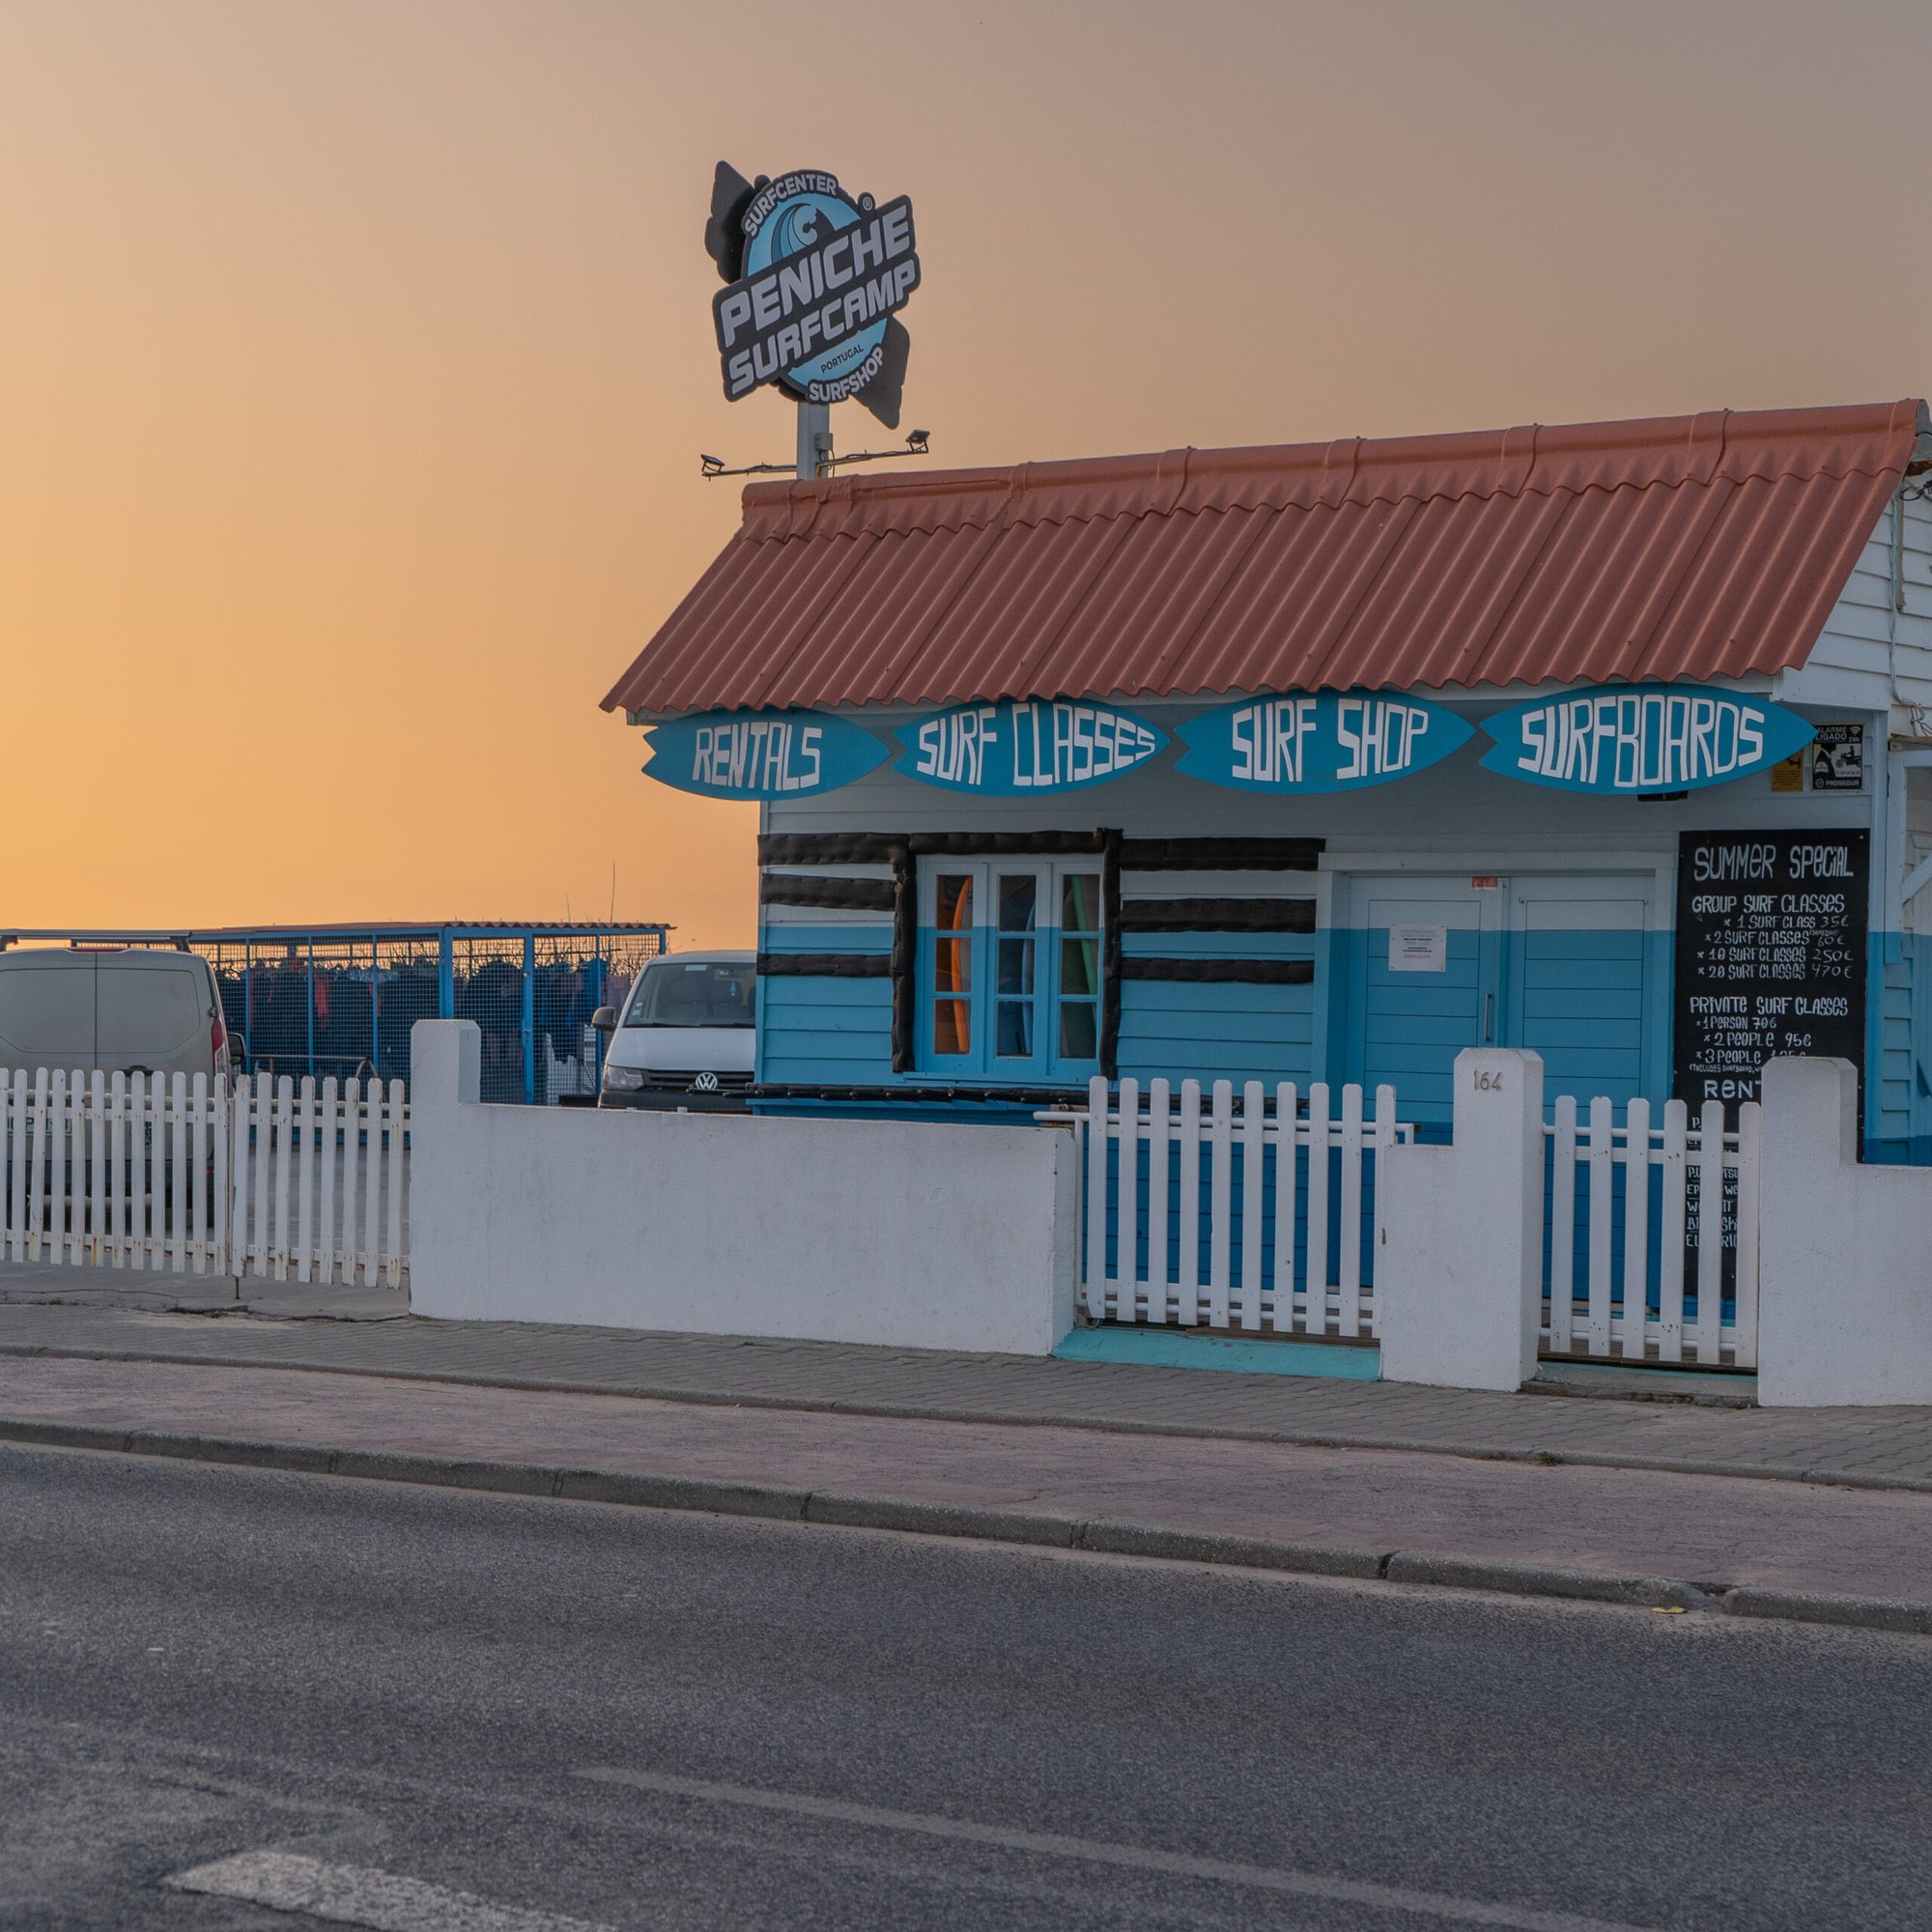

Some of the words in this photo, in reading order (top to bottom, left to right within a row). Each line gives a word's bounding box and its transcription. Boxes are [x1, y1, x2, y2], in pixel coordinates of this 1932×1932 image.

[745, 174, 838, 237] SURFCENTER
[721, 205, 910, 348] PENICHE
[728, 259, 916, 394] SURFCAMP
[821, 344, 865, 374] PORTUGAL
[809, 346, 884, 403] SURFSHOP
[917, 706, 997, 784] SURF
[1013, 702, 1155, 786] CLASSES
[1232, 699, 1317, 781] SURF
[1337, 699, 1429, 780] SHOP
[1518, 695, 1764, 787] SURFBOARDS
[693, 722, 822, 790] RENTALS
[1691, 895, 1737, 914] GROUP
[1743, 895, 1777, 914] SURF
[1737, 915, 1746, 928] 1
[1747, 914, 1780, 928] SURF
[1782, 915, 1816, 928] CLASS
[1714, 930, 1722, 944] 2
[1724, 930, 1756, 945] SURF
[1709, 949, 1726, 961] 10
[1729, 947, 1757, 962] SURF
[1812, 949, 1854, 963] 250€
[1709, 965, 1726, 979] 20
[1728, 964, 1758, 980] SURF
[1812, 963, 1853, 979] 470€
[1756, 997, 1792, 1014] SURF
[1702, 1017, 1709, 1029] 1
[1752, 1017, 1777, 1029] 70€
[1714, 1033, 1725, 1046] 2
[1785, 1033, 1812, 1047] 95€
[1705, 1049, 1715, 1064] 3
[1473, 1069, 1502, 1092] 164
